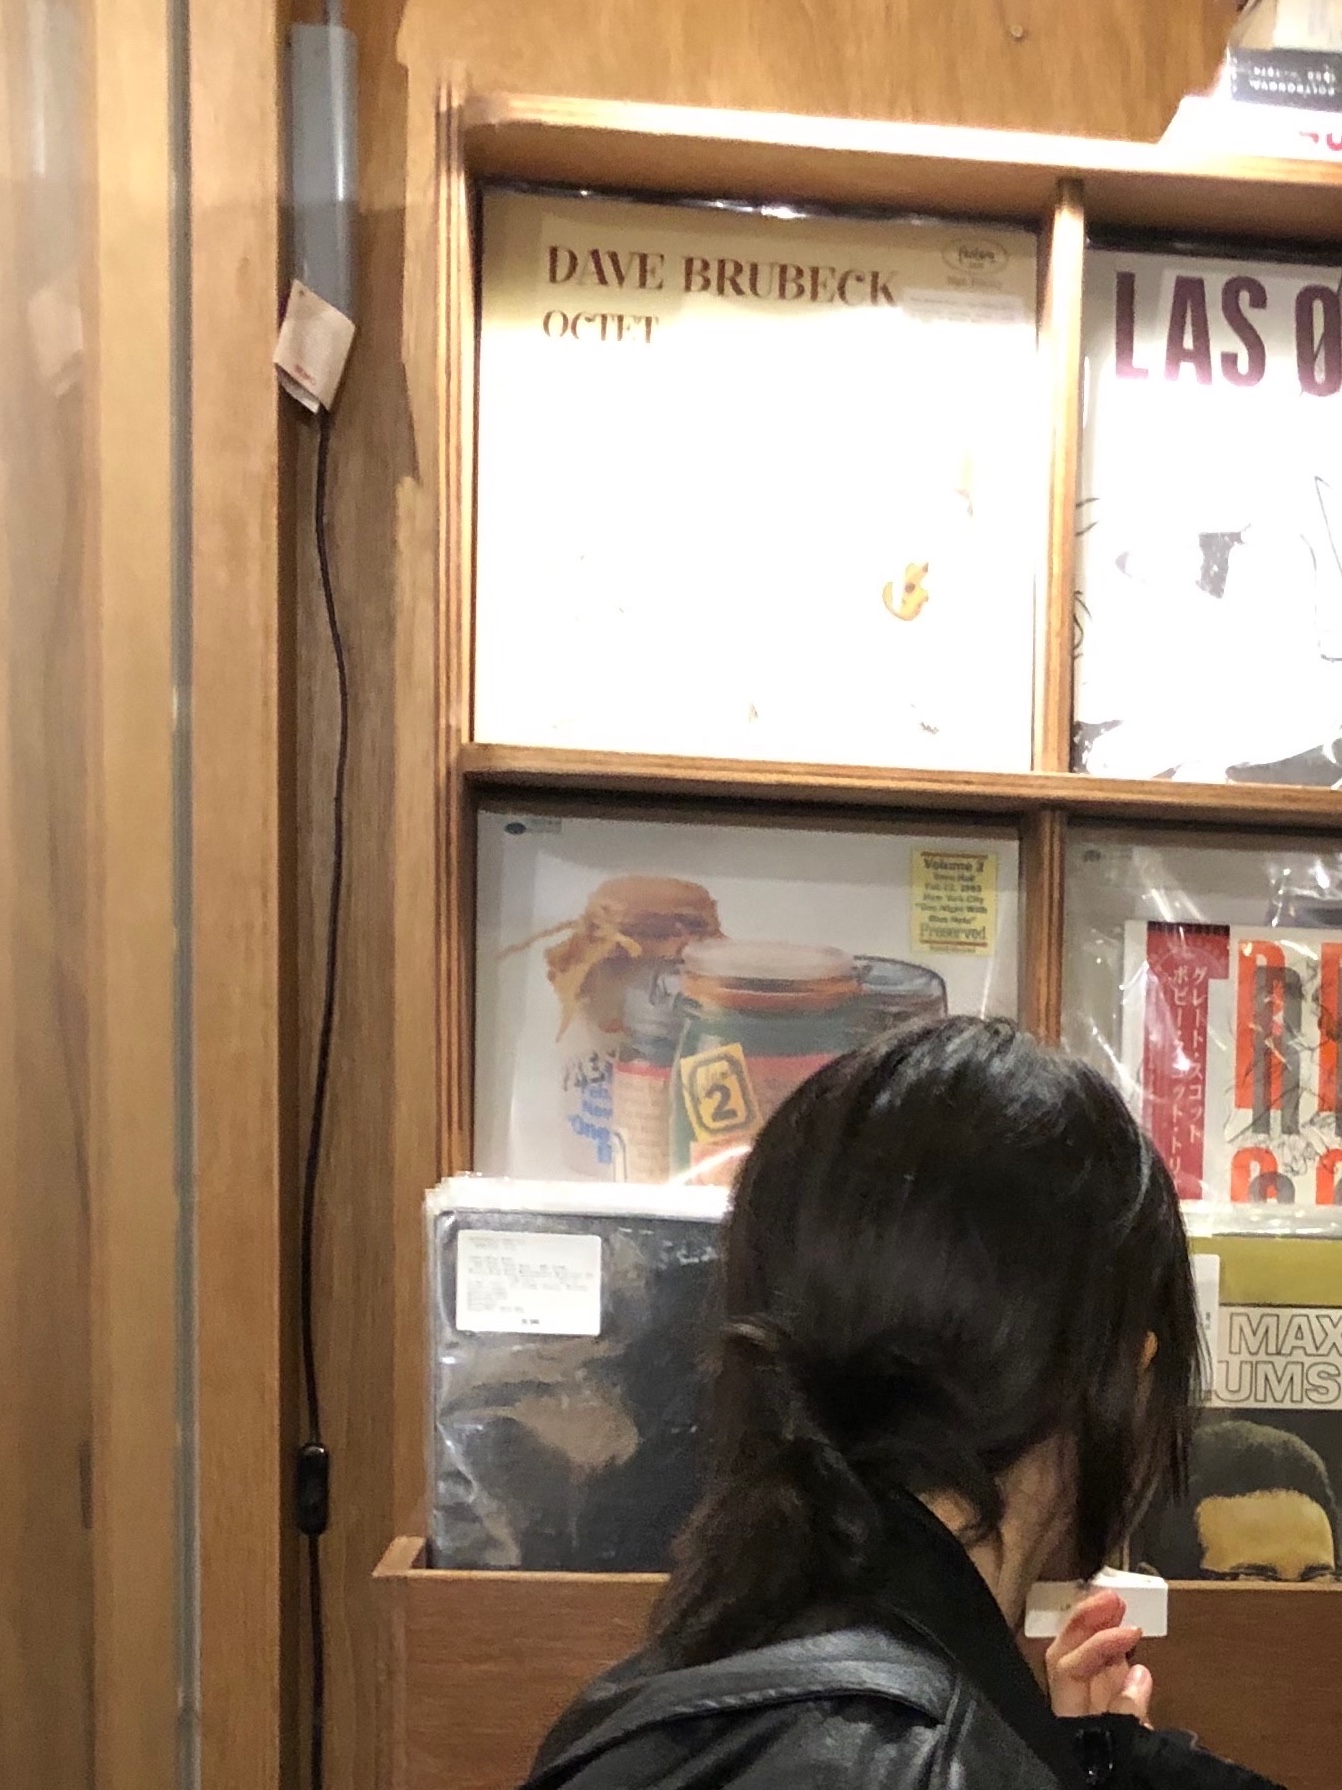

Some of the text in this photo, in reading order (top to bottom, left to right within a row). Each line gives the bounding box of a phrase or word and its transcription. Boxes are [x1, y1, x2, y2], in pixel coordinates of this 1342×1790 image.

[546, 245, 900, 307] DAVE BRUBECK
[542, 309, 660, 344] OCTET
[1115, 270, 1268, 387] LAS
[704, 1081, 736, 1121] 2
